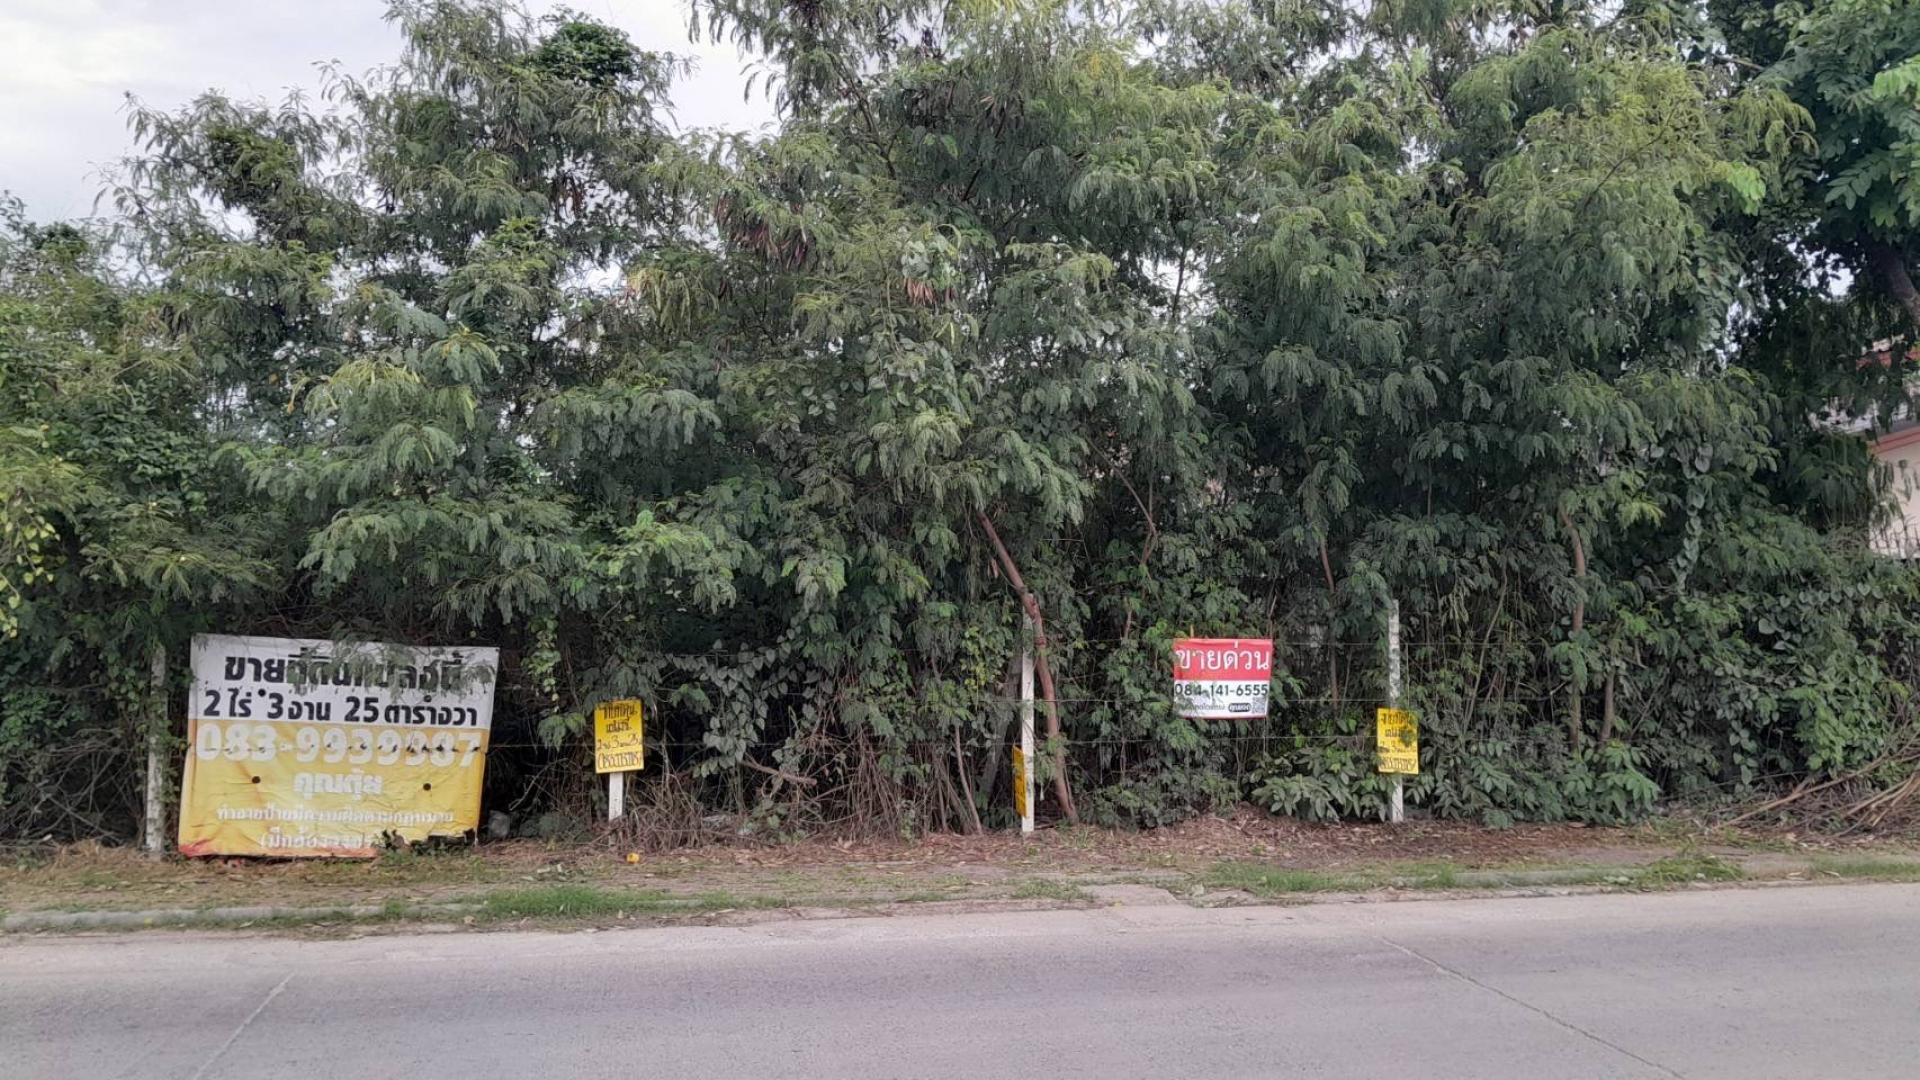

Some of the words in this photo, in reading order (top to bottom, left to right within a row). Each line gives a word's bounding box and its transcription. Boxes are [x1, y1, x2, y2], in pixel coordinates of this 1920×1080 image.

[1175, 641, 1270, 670] ขายด่วน
[1174, 683, 1269, 696] 084-141-6555
[203, 690, 221, 717] 2
[267, 692, 284, 719] 3
[288, 701, 332, 721] งาน
[344, 696, 379, 723] 25
[384, 704, 478, 727] ตารางวา
